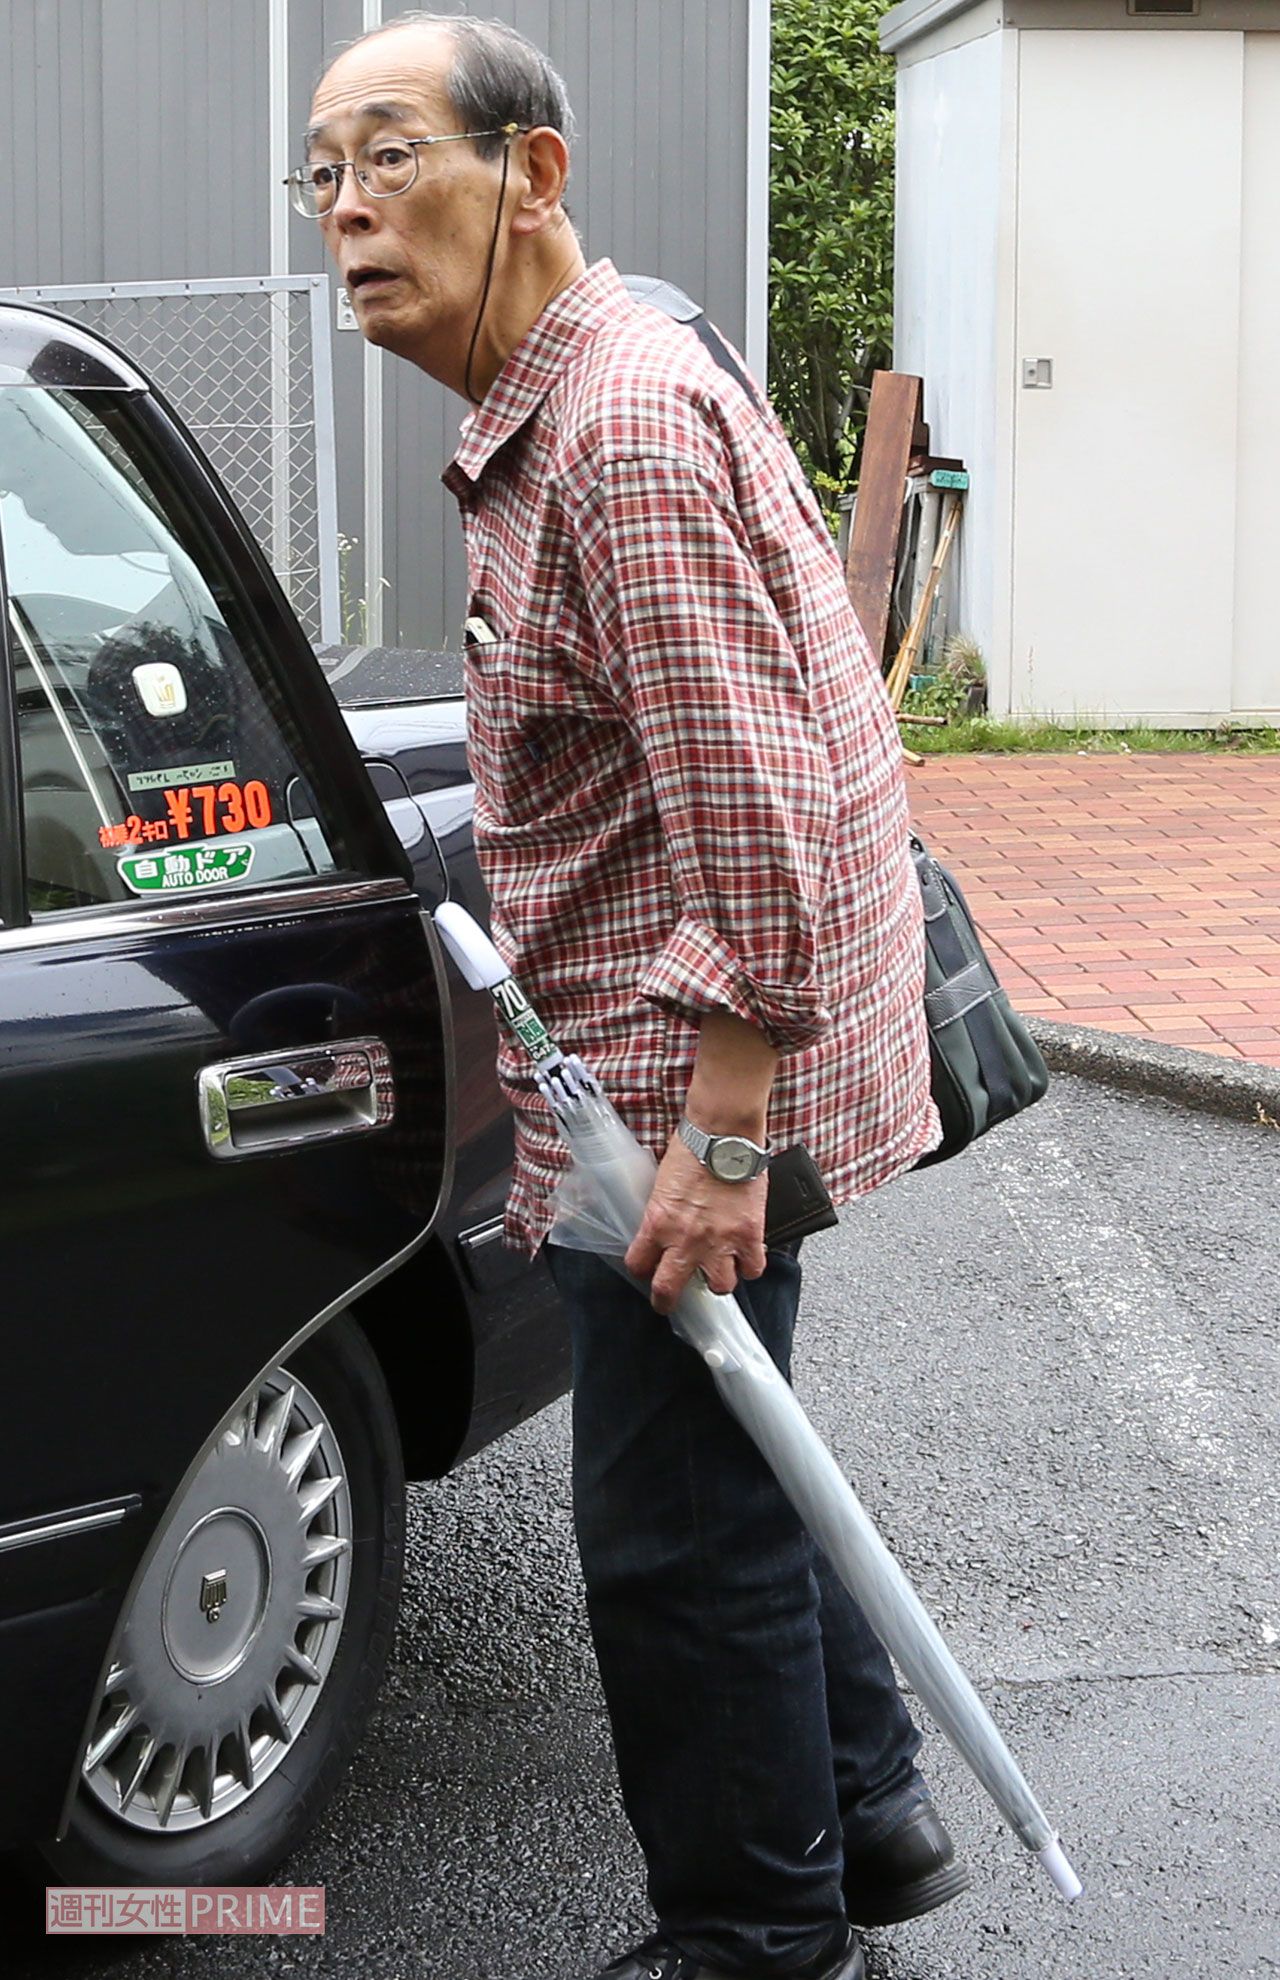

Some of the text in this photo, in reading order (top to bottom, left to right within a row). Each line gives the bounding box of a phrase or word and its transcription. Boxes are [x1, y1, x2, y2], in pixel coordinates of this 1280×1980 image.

[163, 780, 272, 839] ¥730
[134, 847, 247, 879] 自動ドア
[162, 866, 228, 888] AUTO DOOR
[491, 979, 528, 1019] 70
